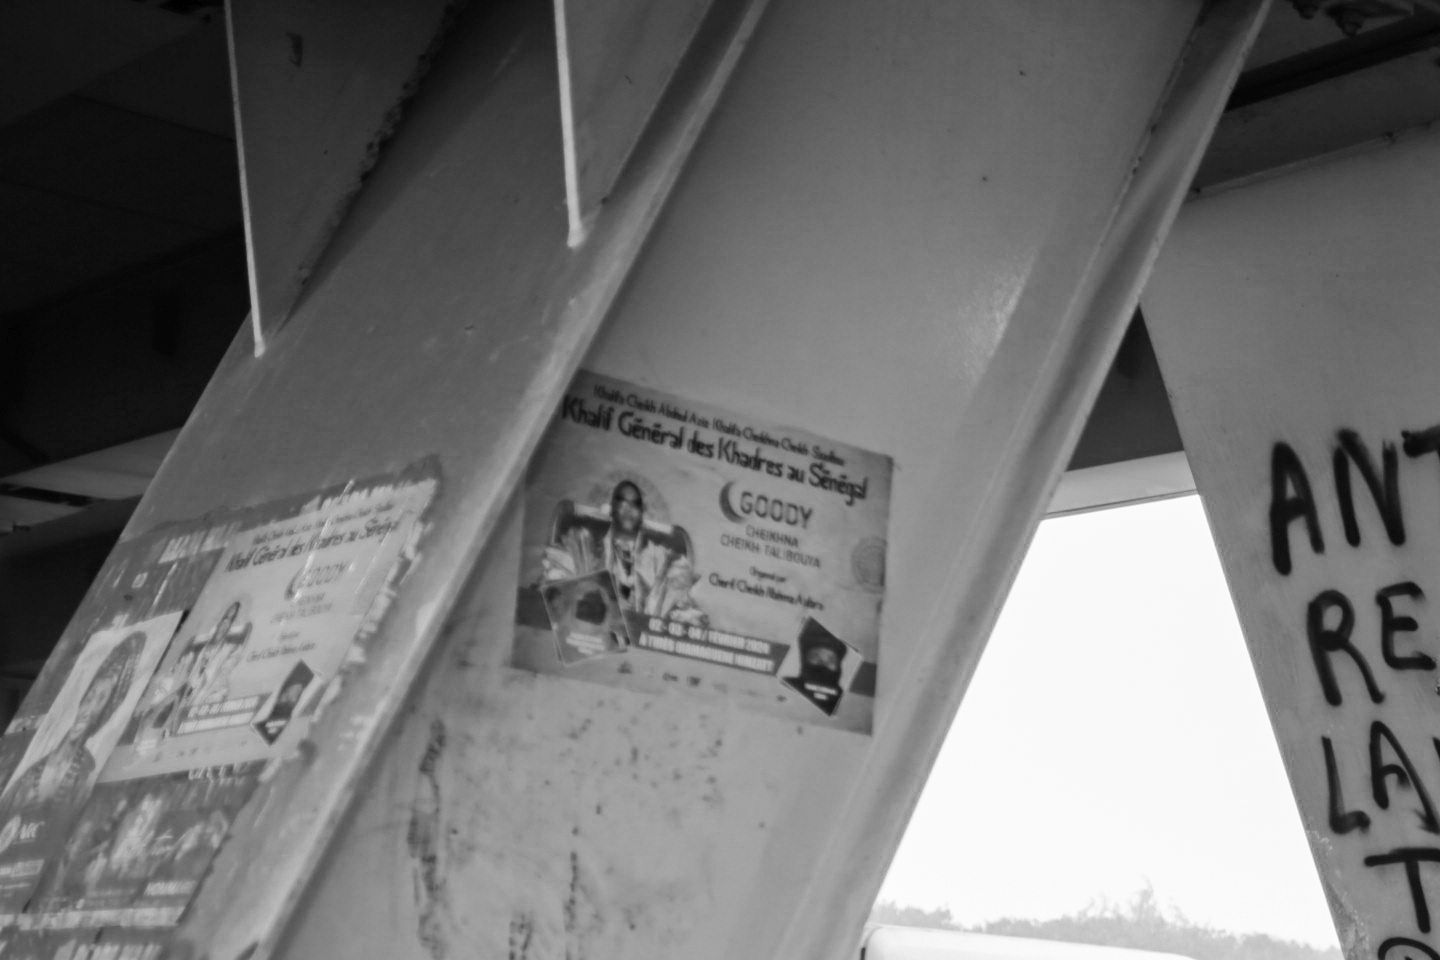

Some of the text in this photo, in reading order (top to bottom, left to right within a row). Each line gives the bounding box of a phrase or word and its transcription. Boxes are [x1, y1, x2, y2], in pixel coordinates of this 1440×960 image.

[562, 394, 868, 507] Khalif Général des Khadres au Sénégal
[740, 491, 813, 529] GOODY
